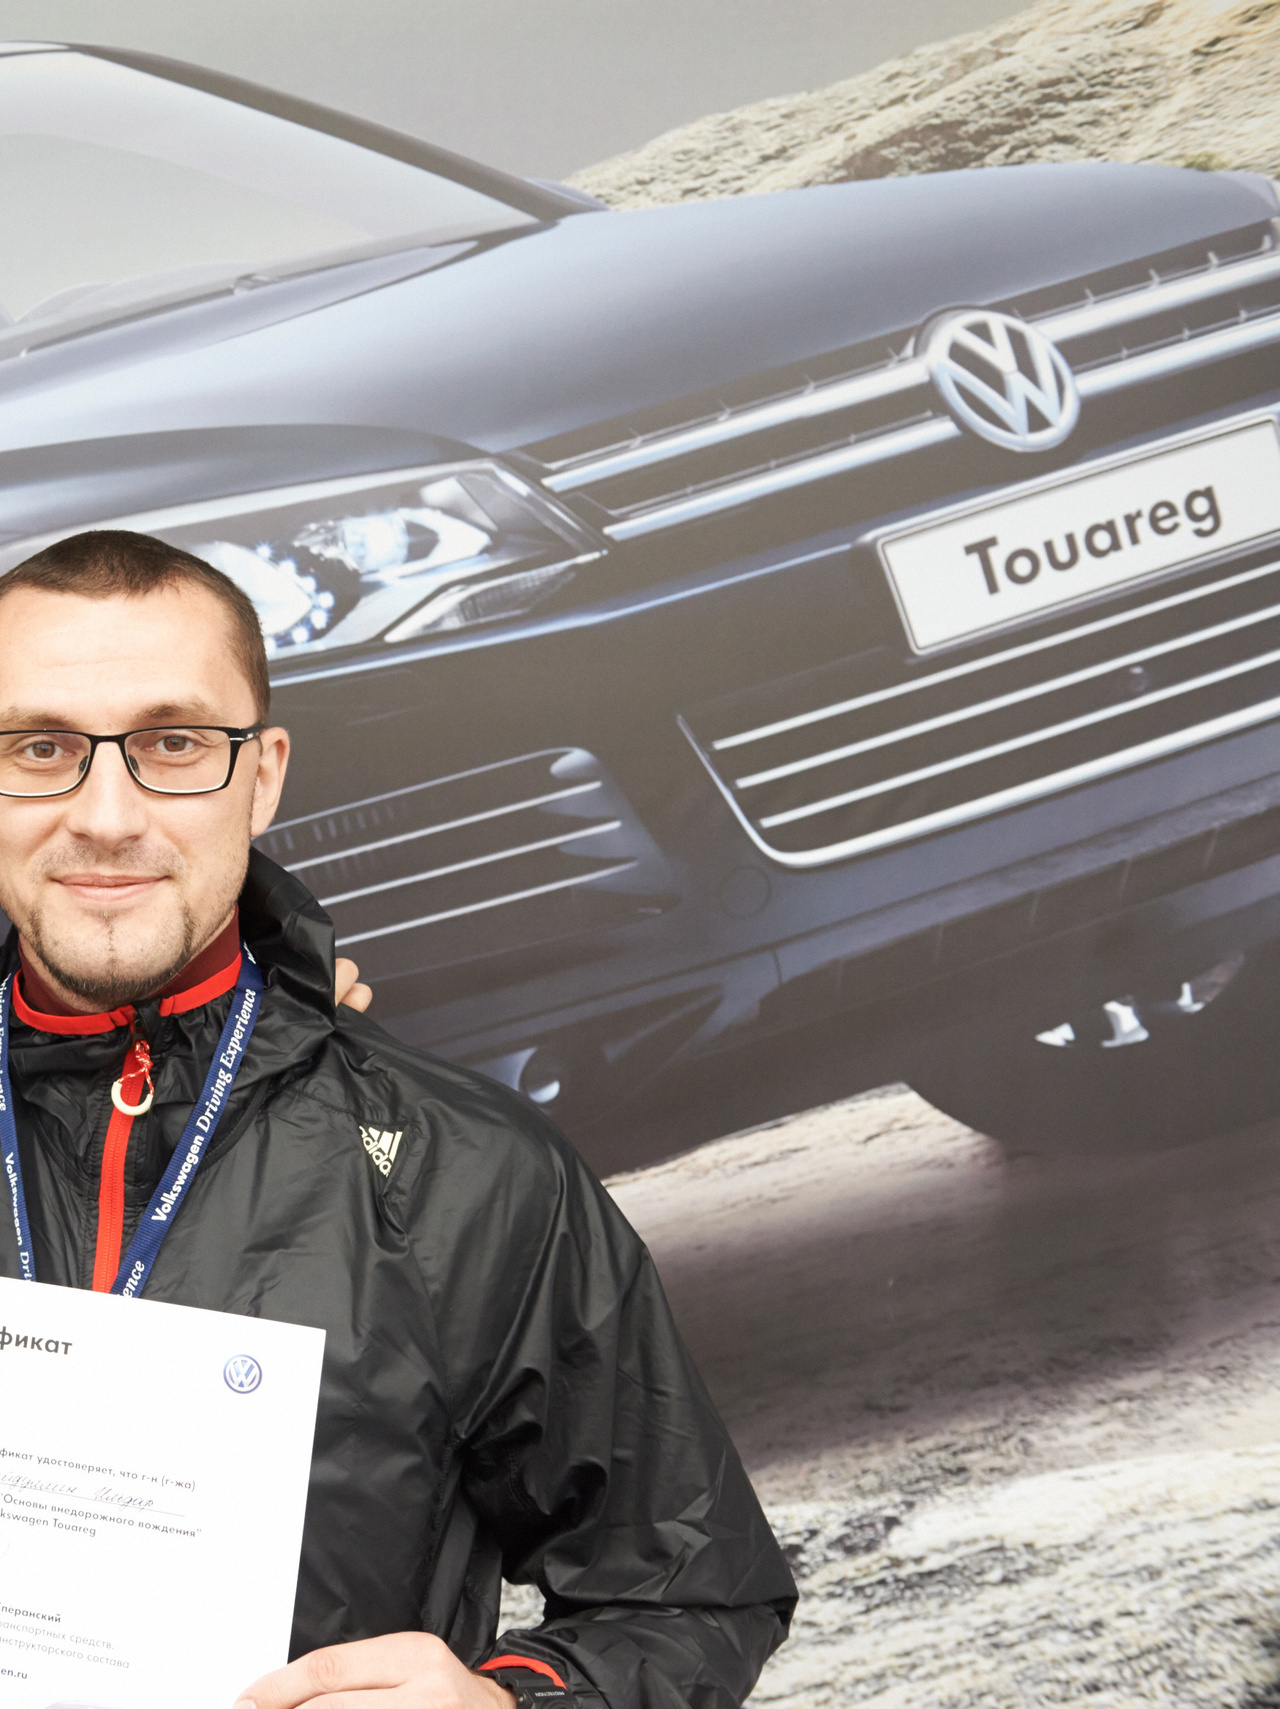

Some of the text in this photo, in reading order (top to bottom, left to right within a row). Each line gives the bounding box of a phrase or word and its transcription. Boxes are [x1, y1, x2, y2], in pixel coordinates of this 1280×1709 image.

[963, 485, 1222, 596] Touareg
[152, 1134, 204, 1222] Volkswagen
[195, 1068, 233, 1133] Driving
[20, 1251, 33, 1281] Dri
[36, 1456, 116, 1477] удостоверяет,
[119, 1469, 138, 1480] что
[141, 1473, 158, 1484] г-н
[161, 1475, 196, 1492] (г-жа)
[50, 1505, 135, 1527] внедорожного
[138, 1520, 202, 1538] вождения"
[52, 1517, 96, 1538] Touareg
[69, 1633, 115, 1650] средств.
[86, 1653, 131, 1669] состава
